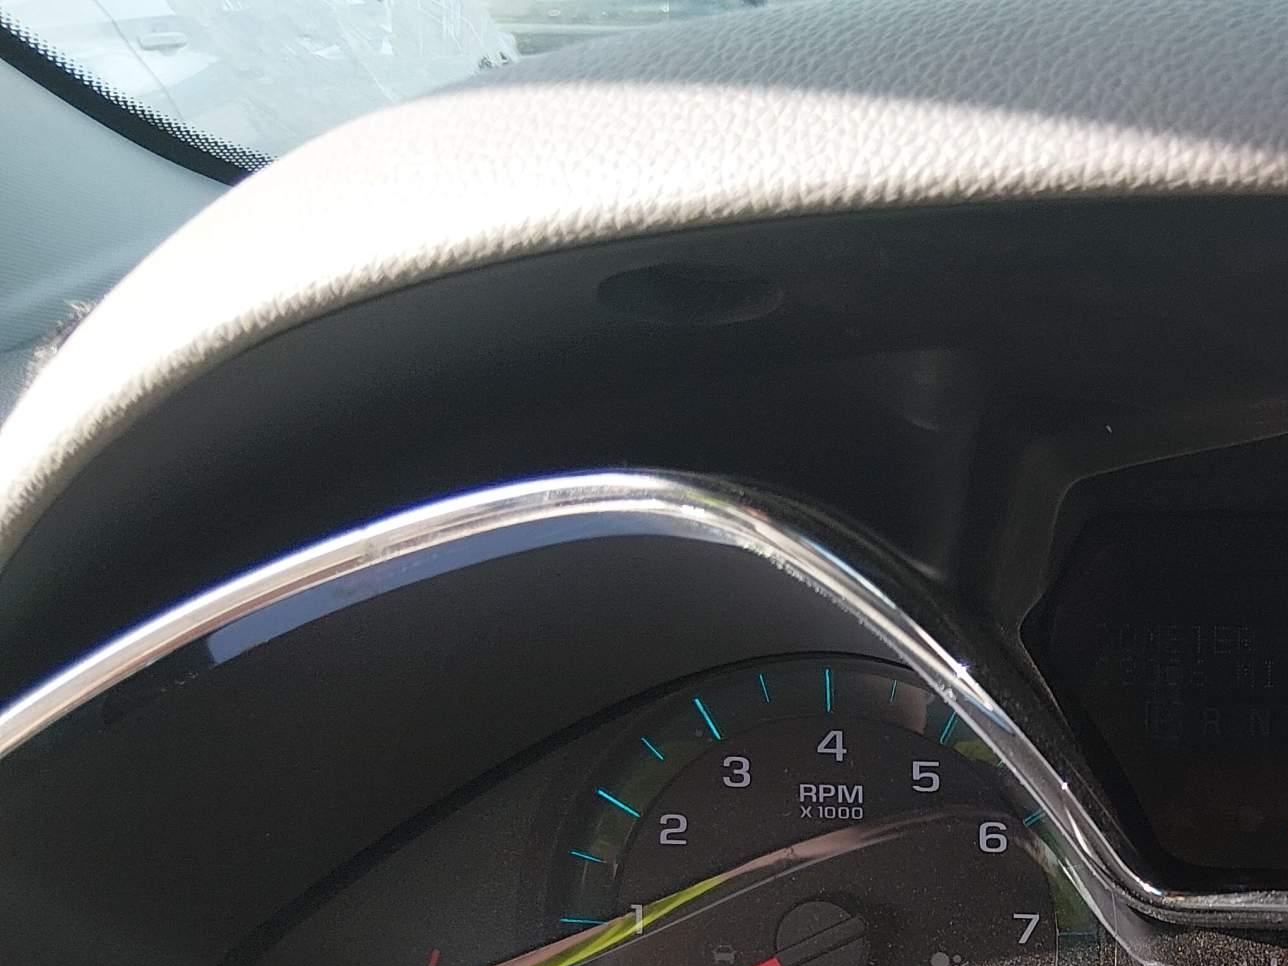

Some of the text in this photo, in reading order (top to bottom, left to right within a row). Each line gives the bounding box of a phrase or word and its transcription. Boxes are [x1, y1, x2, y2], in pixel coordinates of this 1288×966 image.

[816, 729, 847, 761] 4
[721, 756, 752, 787] 3
[910, 760, 941, 792] 5
[799, 783, 863, 803] RPM
[800, 805, 863, 819] X 1000
[659, 814, 688, 845] 2
[978, 821, 1008, 852] 6
[630, 904, 644, 933] 1
[1013, 913, 1040, 944] 7
